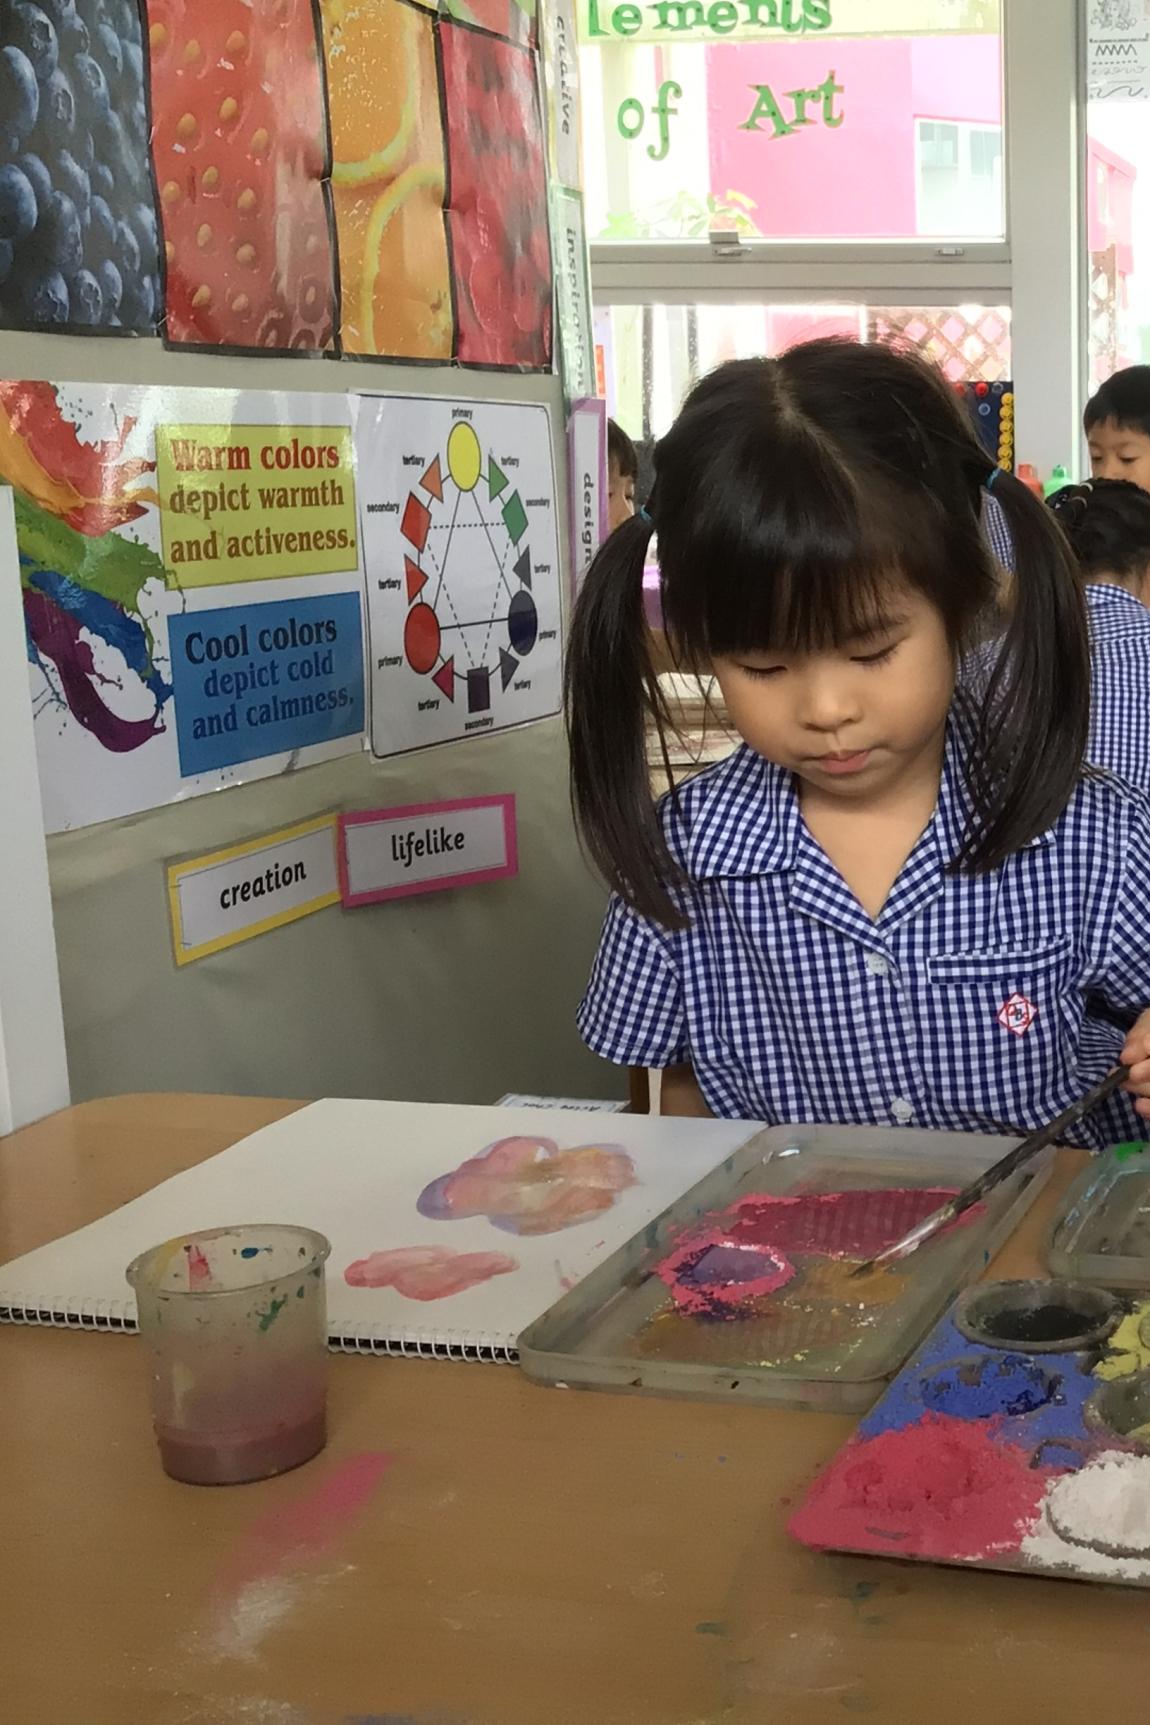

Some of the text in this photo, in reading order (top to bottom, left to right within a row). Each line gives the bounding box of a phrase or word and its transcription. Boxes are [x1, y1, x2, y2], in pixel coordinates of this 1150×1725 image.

[617, 69, 845, 161] of Art
[452, 407, 473, 419] primary
[170, 438, 340, 471] Warm colors
[402, 455, 425, 467] tertiary
[501, 456, 520, 468] tertiary
[169, 479, 345, 520] depict warmth
[366, 501, 400, 513] secondary
[581, 472, 595, 565] design
[170, 526, 356, 563] and activeness.
[378, 578, 401, 590] tertiary
[185, 617, 337, 665] Cool colors
[539, 629, 557, 641] primary
[203, 650, 334, 700] depict cold
[377, 655, 403, 670] primary
[192, 687, 355, 740] and calmness.
[418, 699, 440, 711] tertiary
[464, 716, 494, 731] secondary
[390, 827, 466, 868] lifelike
[219, 859, 307, 909] creation
